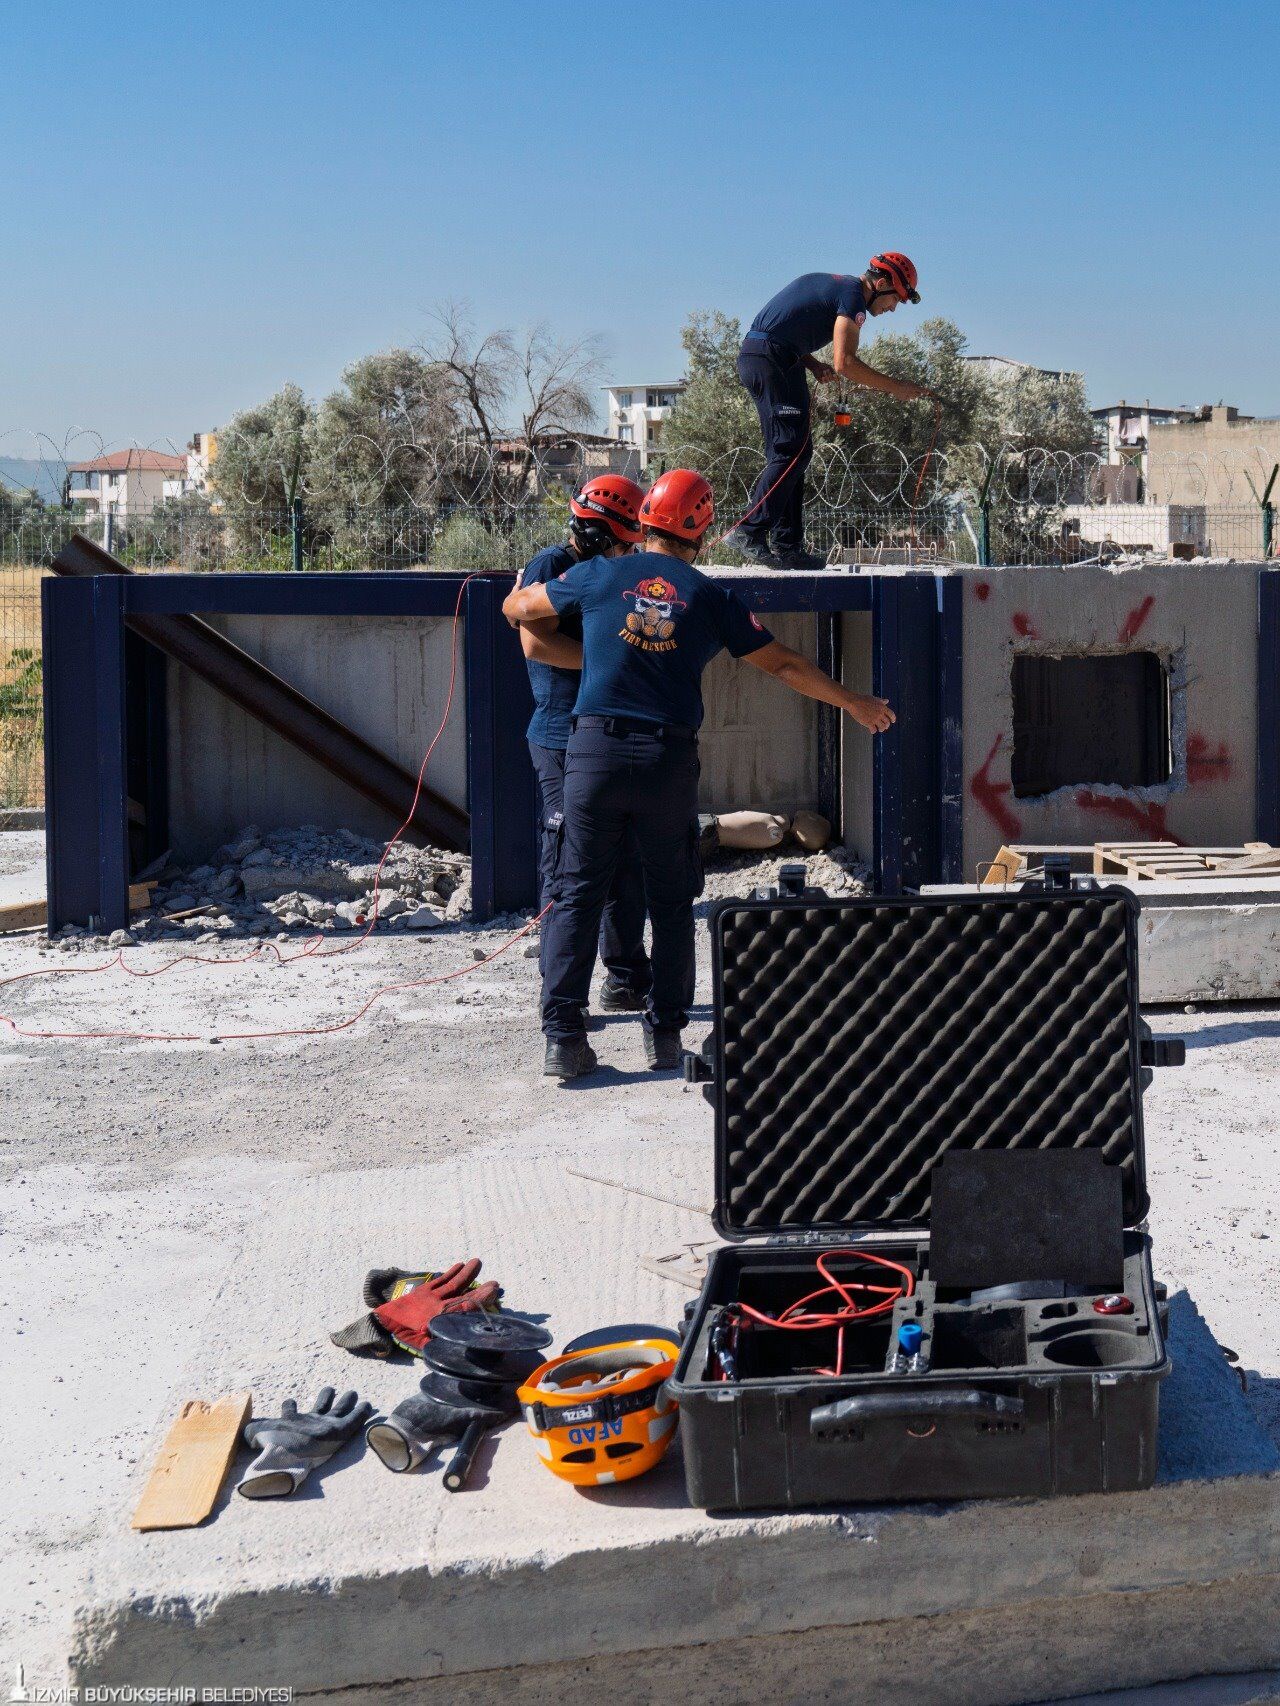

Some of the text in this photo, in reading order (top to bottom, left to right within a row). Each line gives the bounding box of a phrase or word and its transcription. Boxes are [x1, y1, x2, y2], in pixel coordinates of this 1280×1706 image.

[618, 628, 678, 651] FIRE RESCUE
[568, 1418, 624, 1445] AFAD
